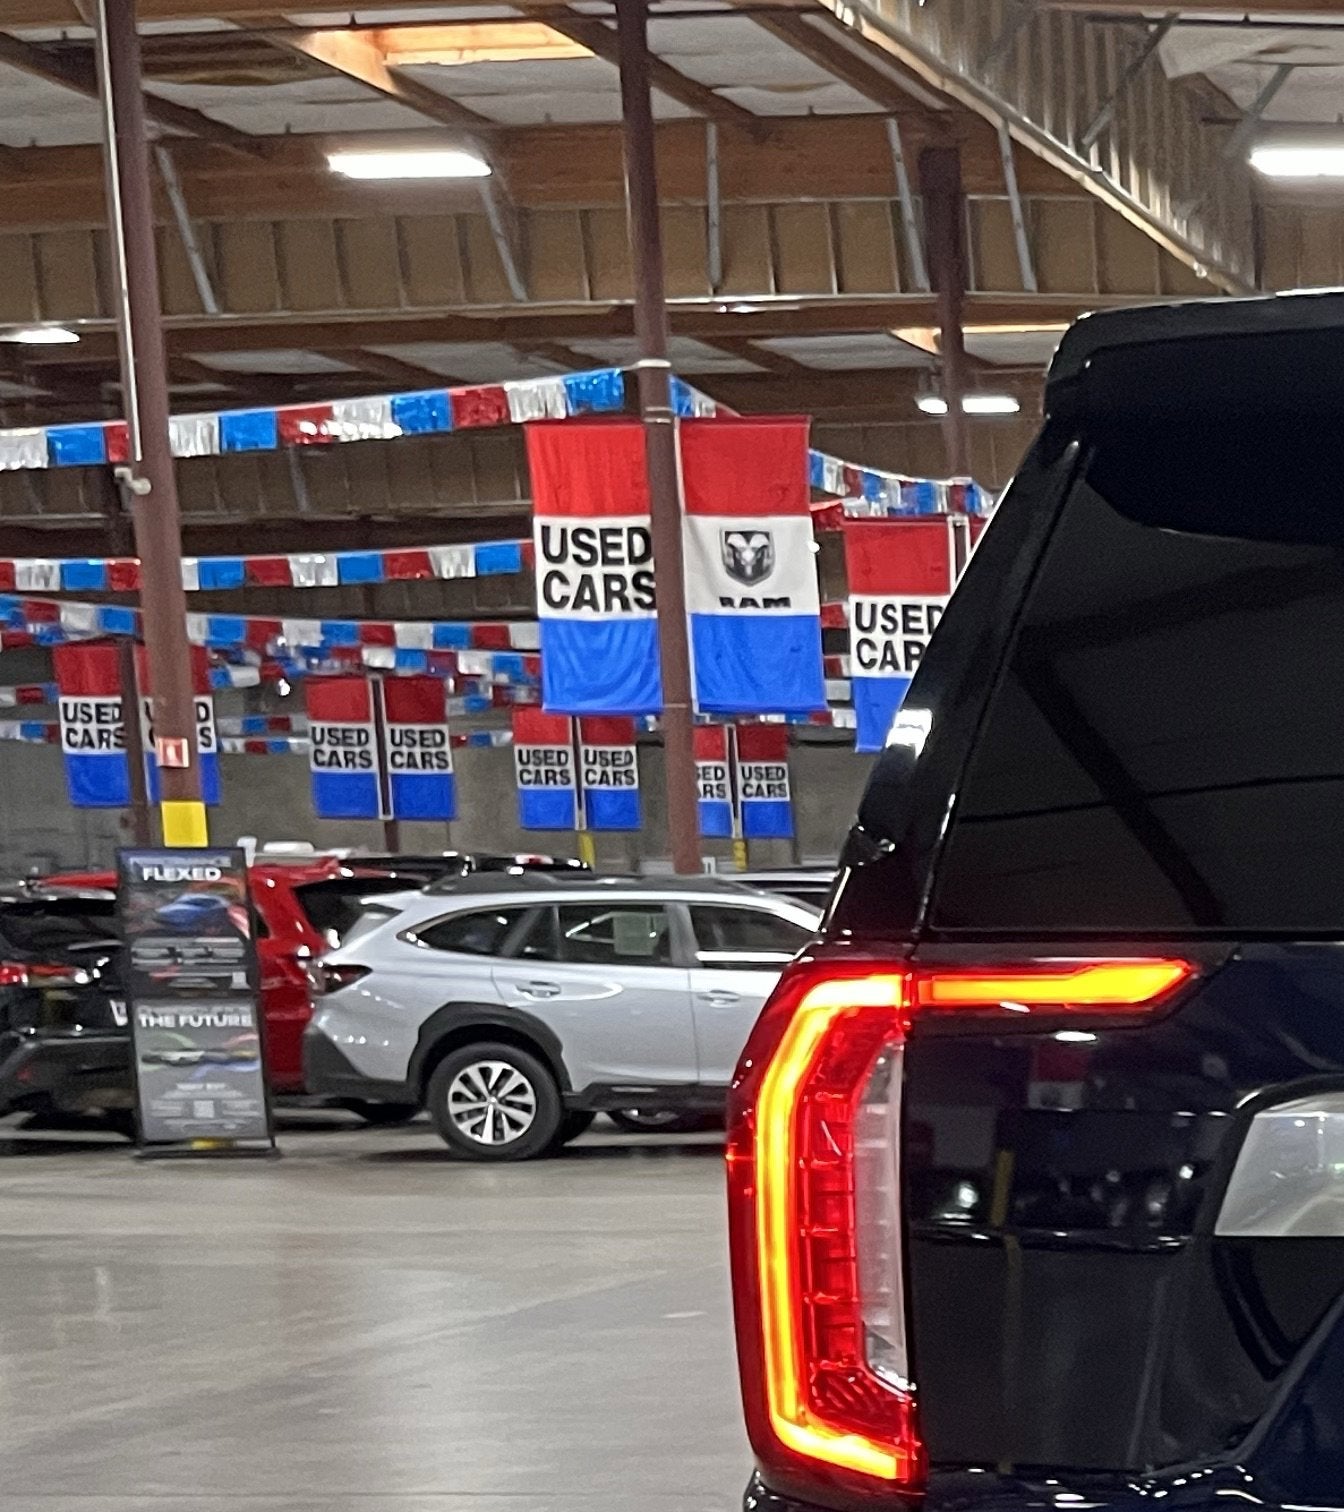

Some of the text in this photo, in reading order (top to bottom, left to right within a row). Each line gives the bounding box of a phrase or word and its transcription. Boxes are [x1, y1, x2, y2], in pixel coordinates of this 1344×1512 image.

[541, 525, 651, 568] USED
[543, 570, 656, 613] CARS
[856, 638, 928, 672] CAR
[311, 726, 370, 747] USED
[390, 728, 446, 748] USED
[313, 749, 373, 769] CARS
[391, 751, 449, 770] CARS
[517, 748, 569, 767] USED
[584, 749, 634, 767] USED
[519, 769, 571, 786] CARS
[584, 769, 635, 786] CARS
[741, 766, 786, 781] USED
[742, 783, 788, 798] CARS
[143, 867, 222, 881] FLEXED
[139, 1014, 253, 1028] THE FUTURE
